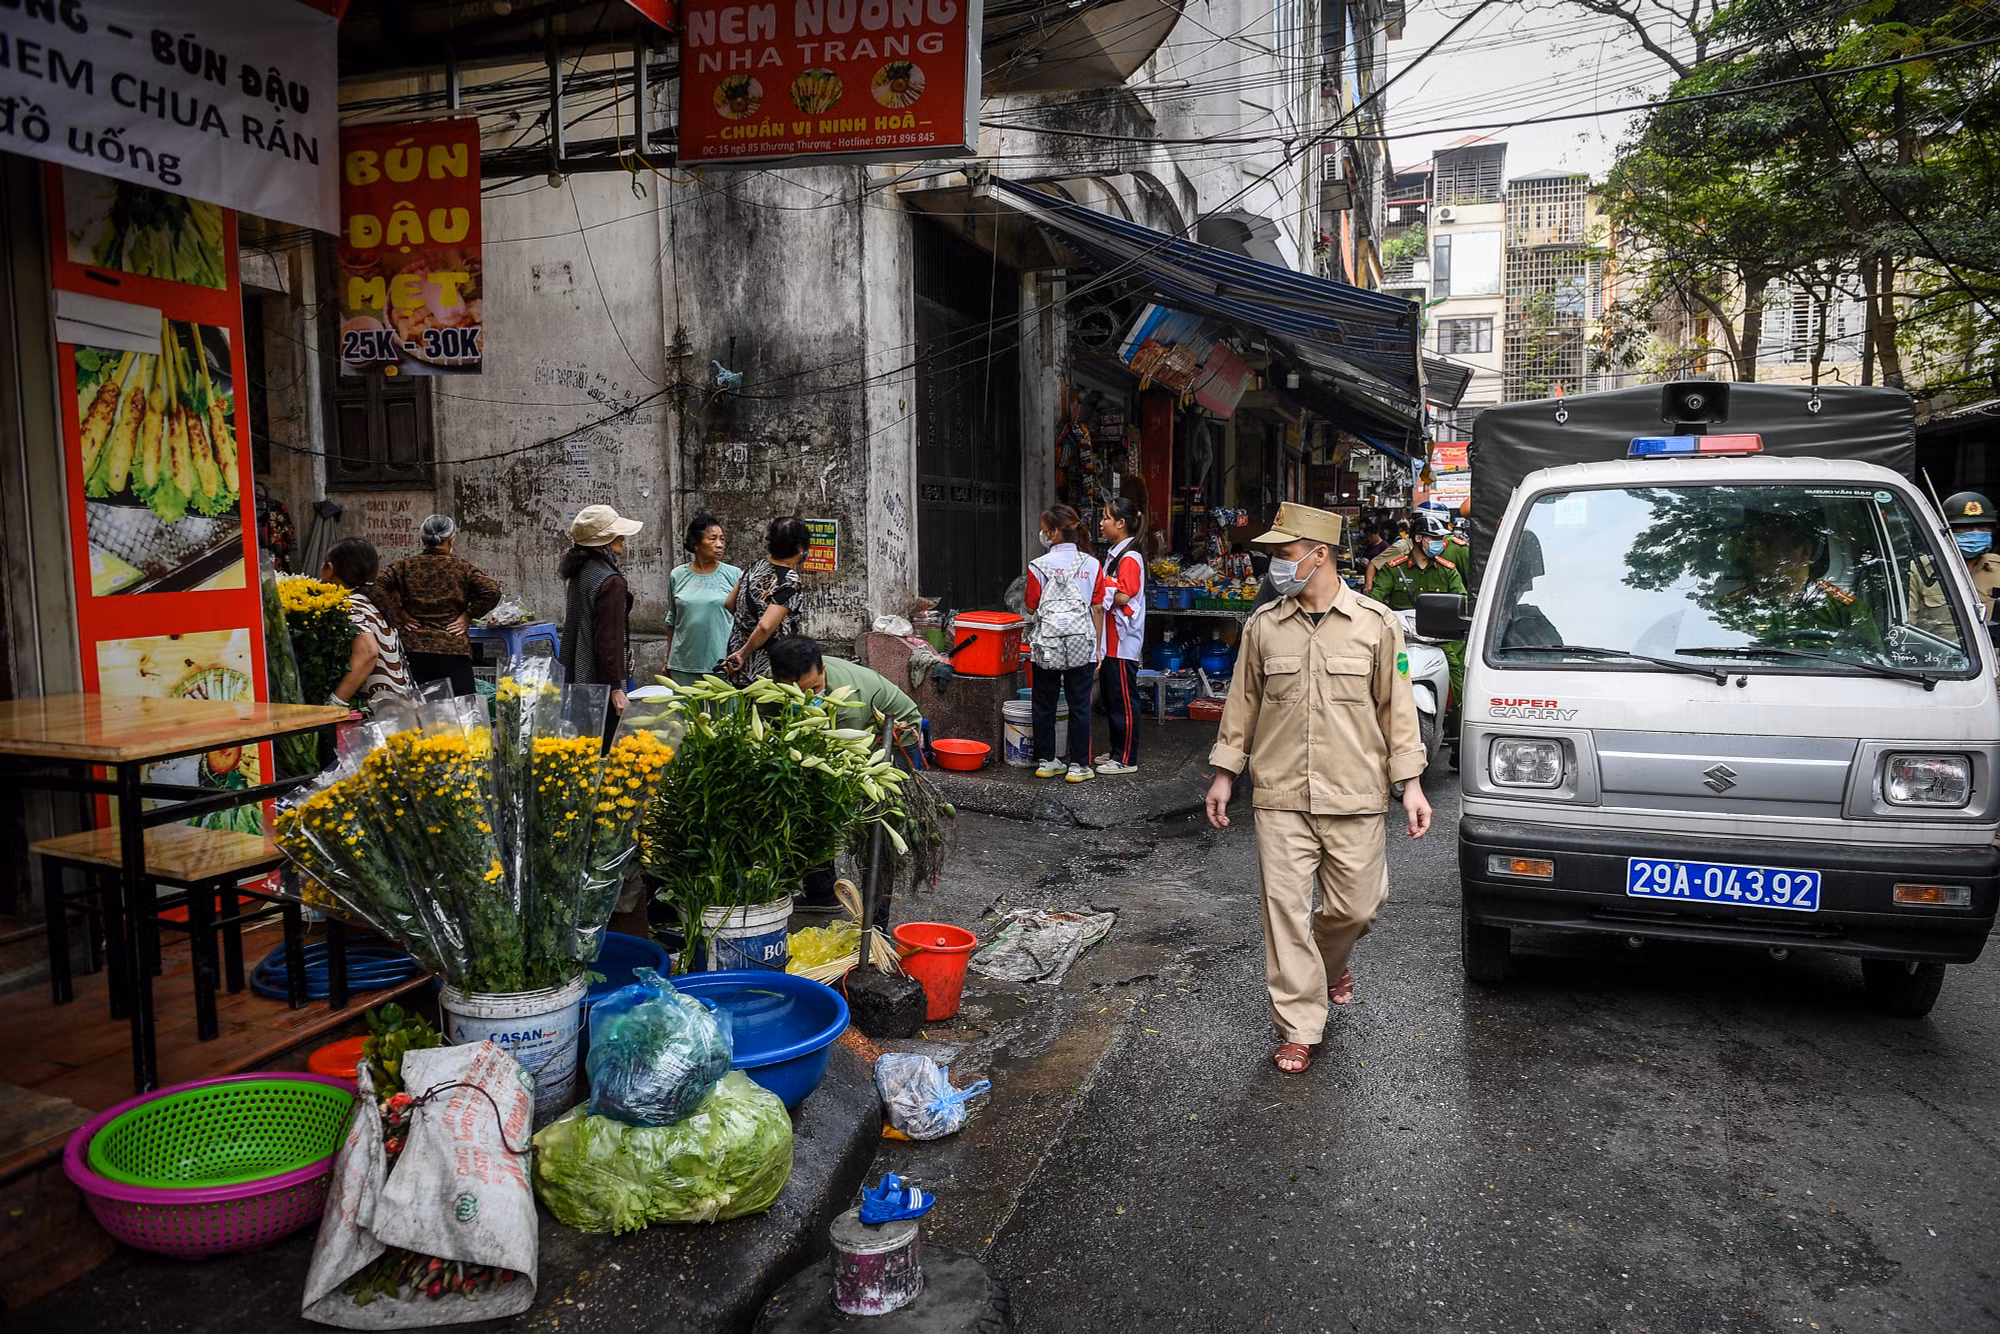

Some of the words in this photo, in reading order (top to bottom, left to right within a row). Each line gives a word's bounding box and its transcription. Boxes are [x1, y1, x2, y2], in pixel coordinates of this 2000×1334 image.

[688, 3, 777, 48] NEM
[151, 29, 227, 86] BÚN
[239, 64, 309, 114] ĐẬU
[699, 47, 783, 73] NHA
[797, 32, 945, 64] TRANG
[111, 72, 229, 138] CHUA
[242, 114, 319, 165] RÁN
[720, 116, 785, 140] CHUẨN
[792, 121, 812, 138] VỊ
[819, 118, 867, 134] NINH
[875, 110, 916, 130] HOÀ
[68, 124, 182, 186] uống
[345, 137, 468, 186] BÚN
[719, 144, 729, 154] 15
[748, 142, 759, 152] 85
[838, 136, 874, 147] Hotline:
[876, 133, 897, 145] 0971
[900, 133, 916, 143] 896
[918, 132, 935, 142] 845
[343, 200, 470, 253] ĐẬU
[347, 272, 470, 317] MẸT
[343, 328, 398, 361] 25K
[423, 327, 481, 361] 30K
[1489, 706, 1579, 721] CARRY
[1490, 698, 1558, 708] SUPER
[1632, 862, 1813, 907] 29A-043.92
[490, 1028, 543, 1044] CASAN
